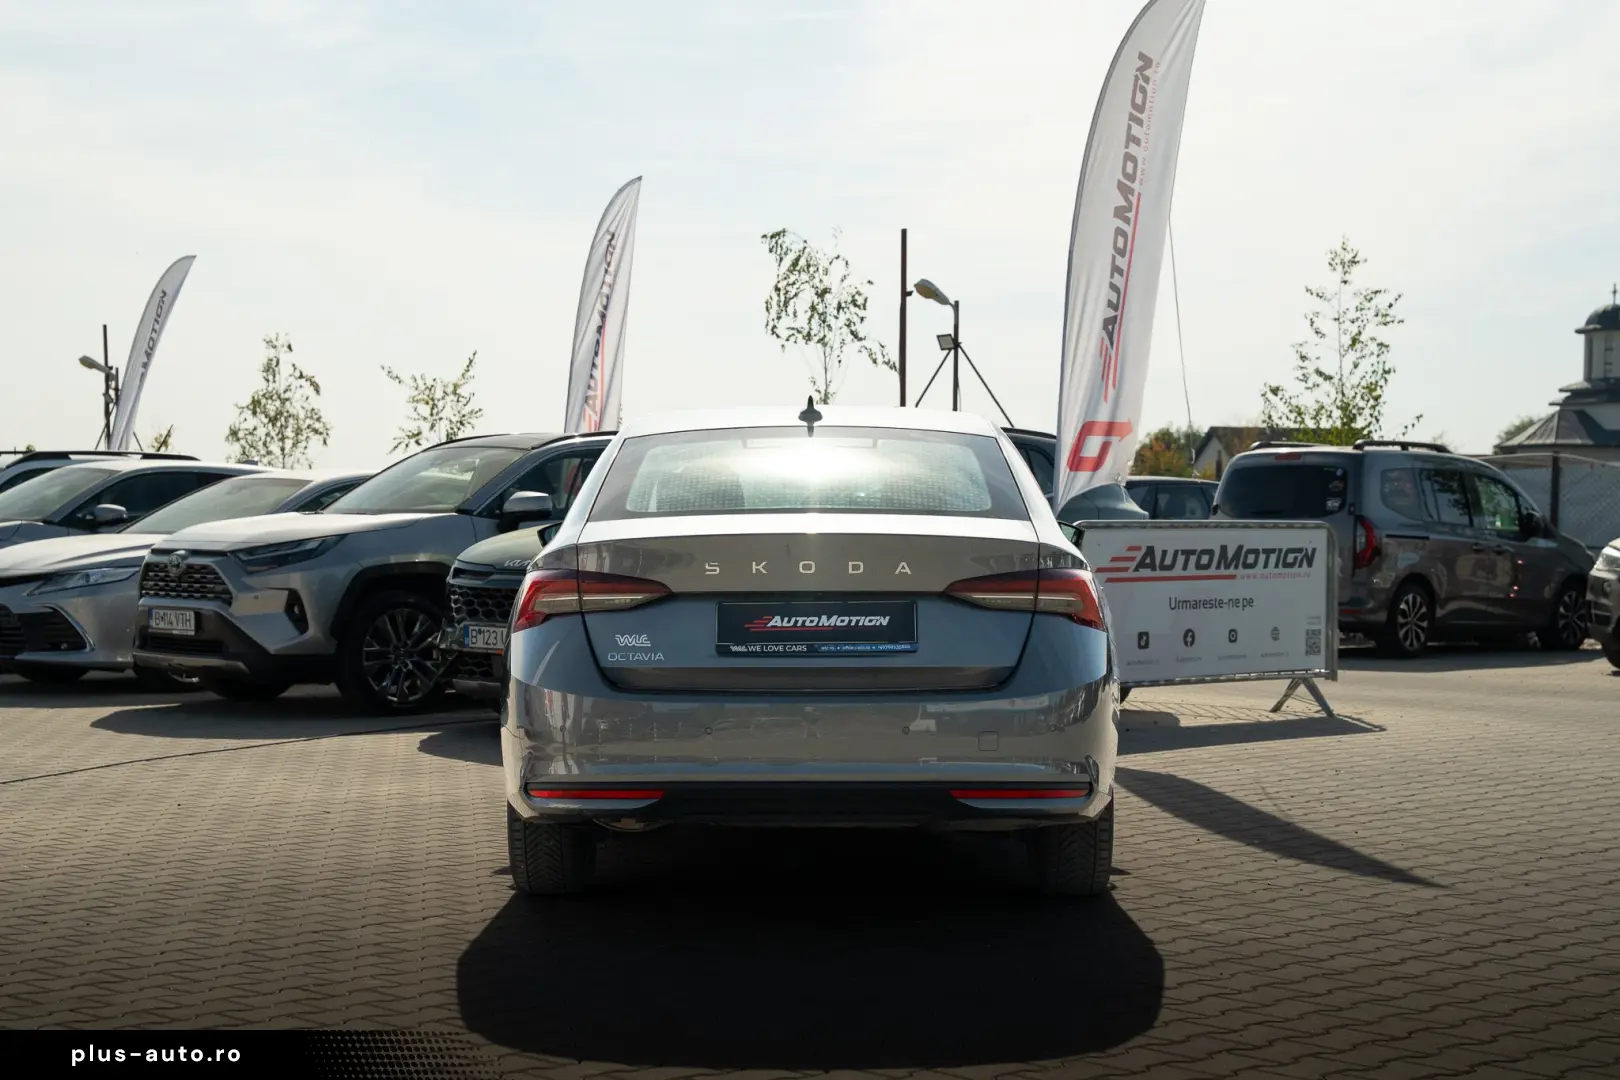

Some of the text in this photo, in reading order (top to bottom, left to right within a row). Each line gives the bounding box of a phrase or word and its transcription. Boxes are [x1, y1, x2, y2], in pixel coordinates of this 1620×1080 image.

[141, 288, 167, 372] MOTION
[1168, 596, 1254, 611] Urmareste-ne pe
[471, 628, 478, 645] B
[481, 629, 498, 646] 123
[607, 652, 665, 661] OCTAVIA
